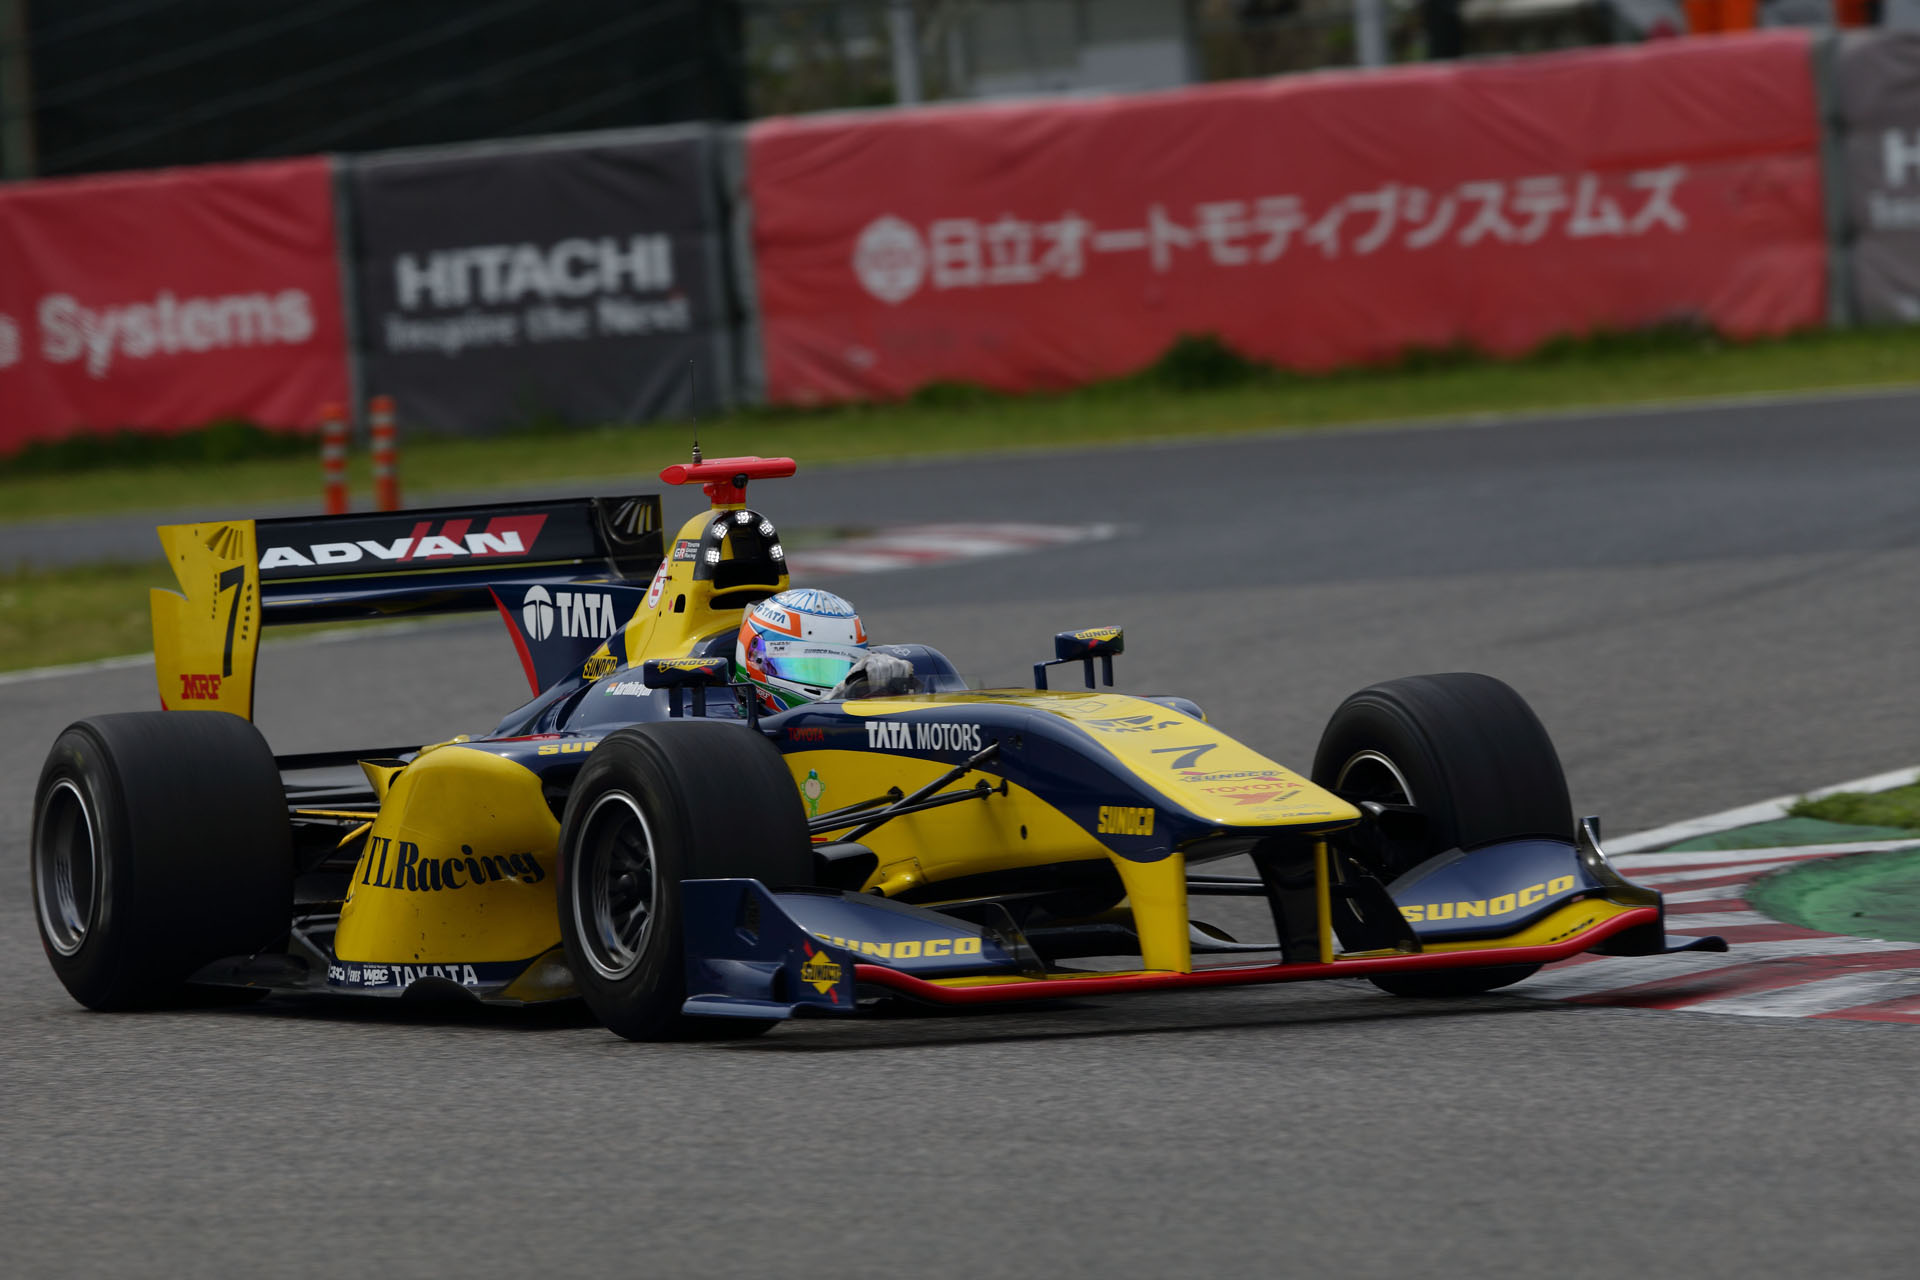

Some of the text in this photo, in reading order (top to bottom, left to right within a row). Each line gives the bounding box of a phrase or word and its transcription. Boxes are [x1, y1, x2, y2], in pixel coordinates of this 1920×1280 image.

[398, 238, 671, 310] HITACHI
[39, 290, 314, 378] Systems
[259, 531, 525, 569] ADVAN
[220, 565, 245, 677] 7
[556, 592, 617, 638] TATA
[762, 606, 786, 624] TATA
[659, 659, 715, 670] SUNOCO
[180, 674, 221, 700] MRF
[787, 727, 825, 742] TOYOTA
[865, 721, 981, 751] TATA MOTORS
[1151, 743, 1217, 769] 7
[1189, 770, 1275, 781] SUNOCO
[1200, 782, 1304, 794] TOYOTA
[1098, 805, 1155, 836] SUNOCO
[1398, 874, 1575, 922] SUNOCO
